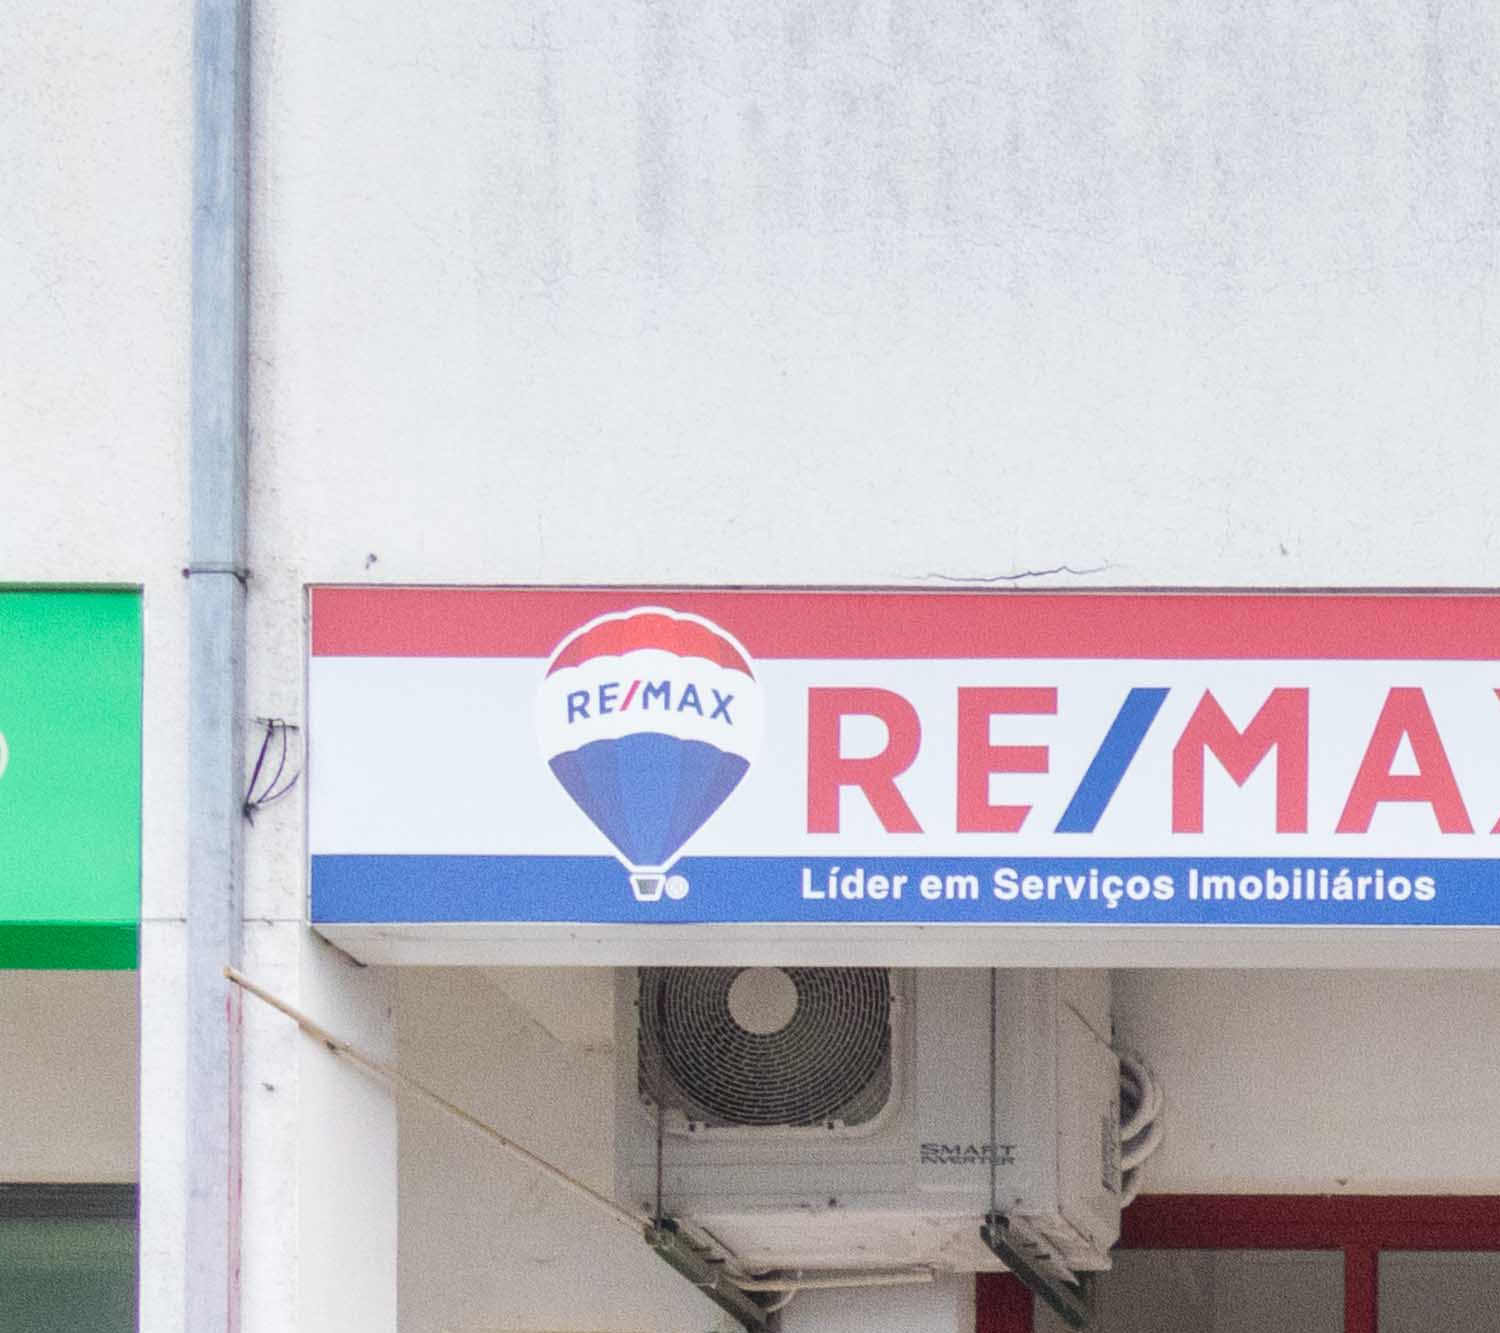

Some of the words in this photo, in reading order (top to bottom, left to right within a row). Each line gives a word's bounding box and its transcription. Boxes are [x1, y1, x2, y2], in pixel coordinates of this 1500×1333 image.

[567, 679, 735, 726] RE/MAX
[801, 866, 910, 900] Líder
[920, 875, 979, 900] em
[993, 866, 1174, 907] Serviços
[1189, 866, 1436, 902] Imobiliários
[920, 1143, 1016, 1155] SMART
